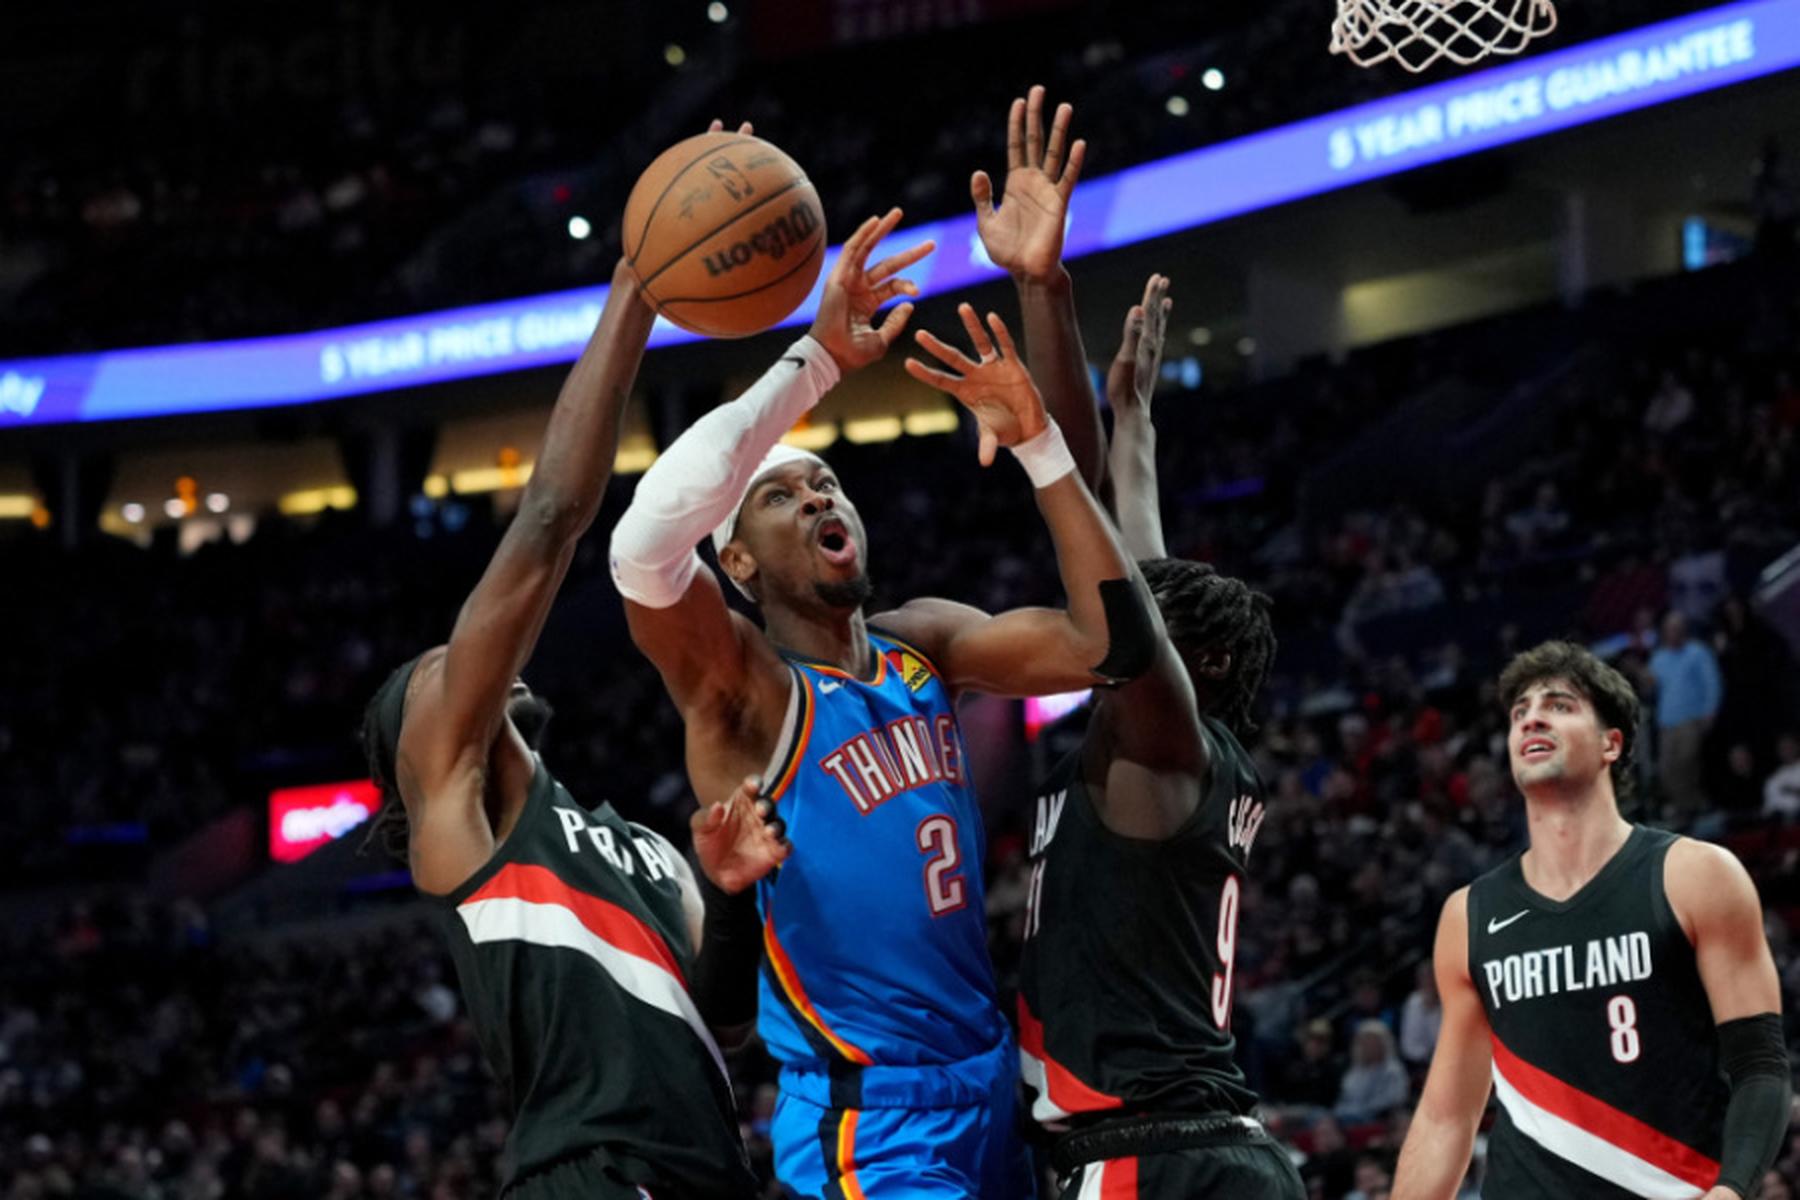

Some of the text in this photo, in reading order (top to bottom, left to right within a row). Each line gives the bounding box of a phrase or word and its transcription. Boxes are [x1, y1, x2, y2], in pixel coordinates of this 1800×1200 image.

[1355, 104, 1443, 161] YEAR
[1445, 74, 1543, 137] PRICE
[1545, 18, 1756, 110] GUARANTEE
[347, 331, 424, 379] YEAR
[427, 314, 512, 365] PRICE
[915, 813, 968, 918] 2
[1211, 873, 1239, 1030] 9
[1483, 930, 1653, 1010] PORTLAND
[1606, 993, 1641, 1064] 8
